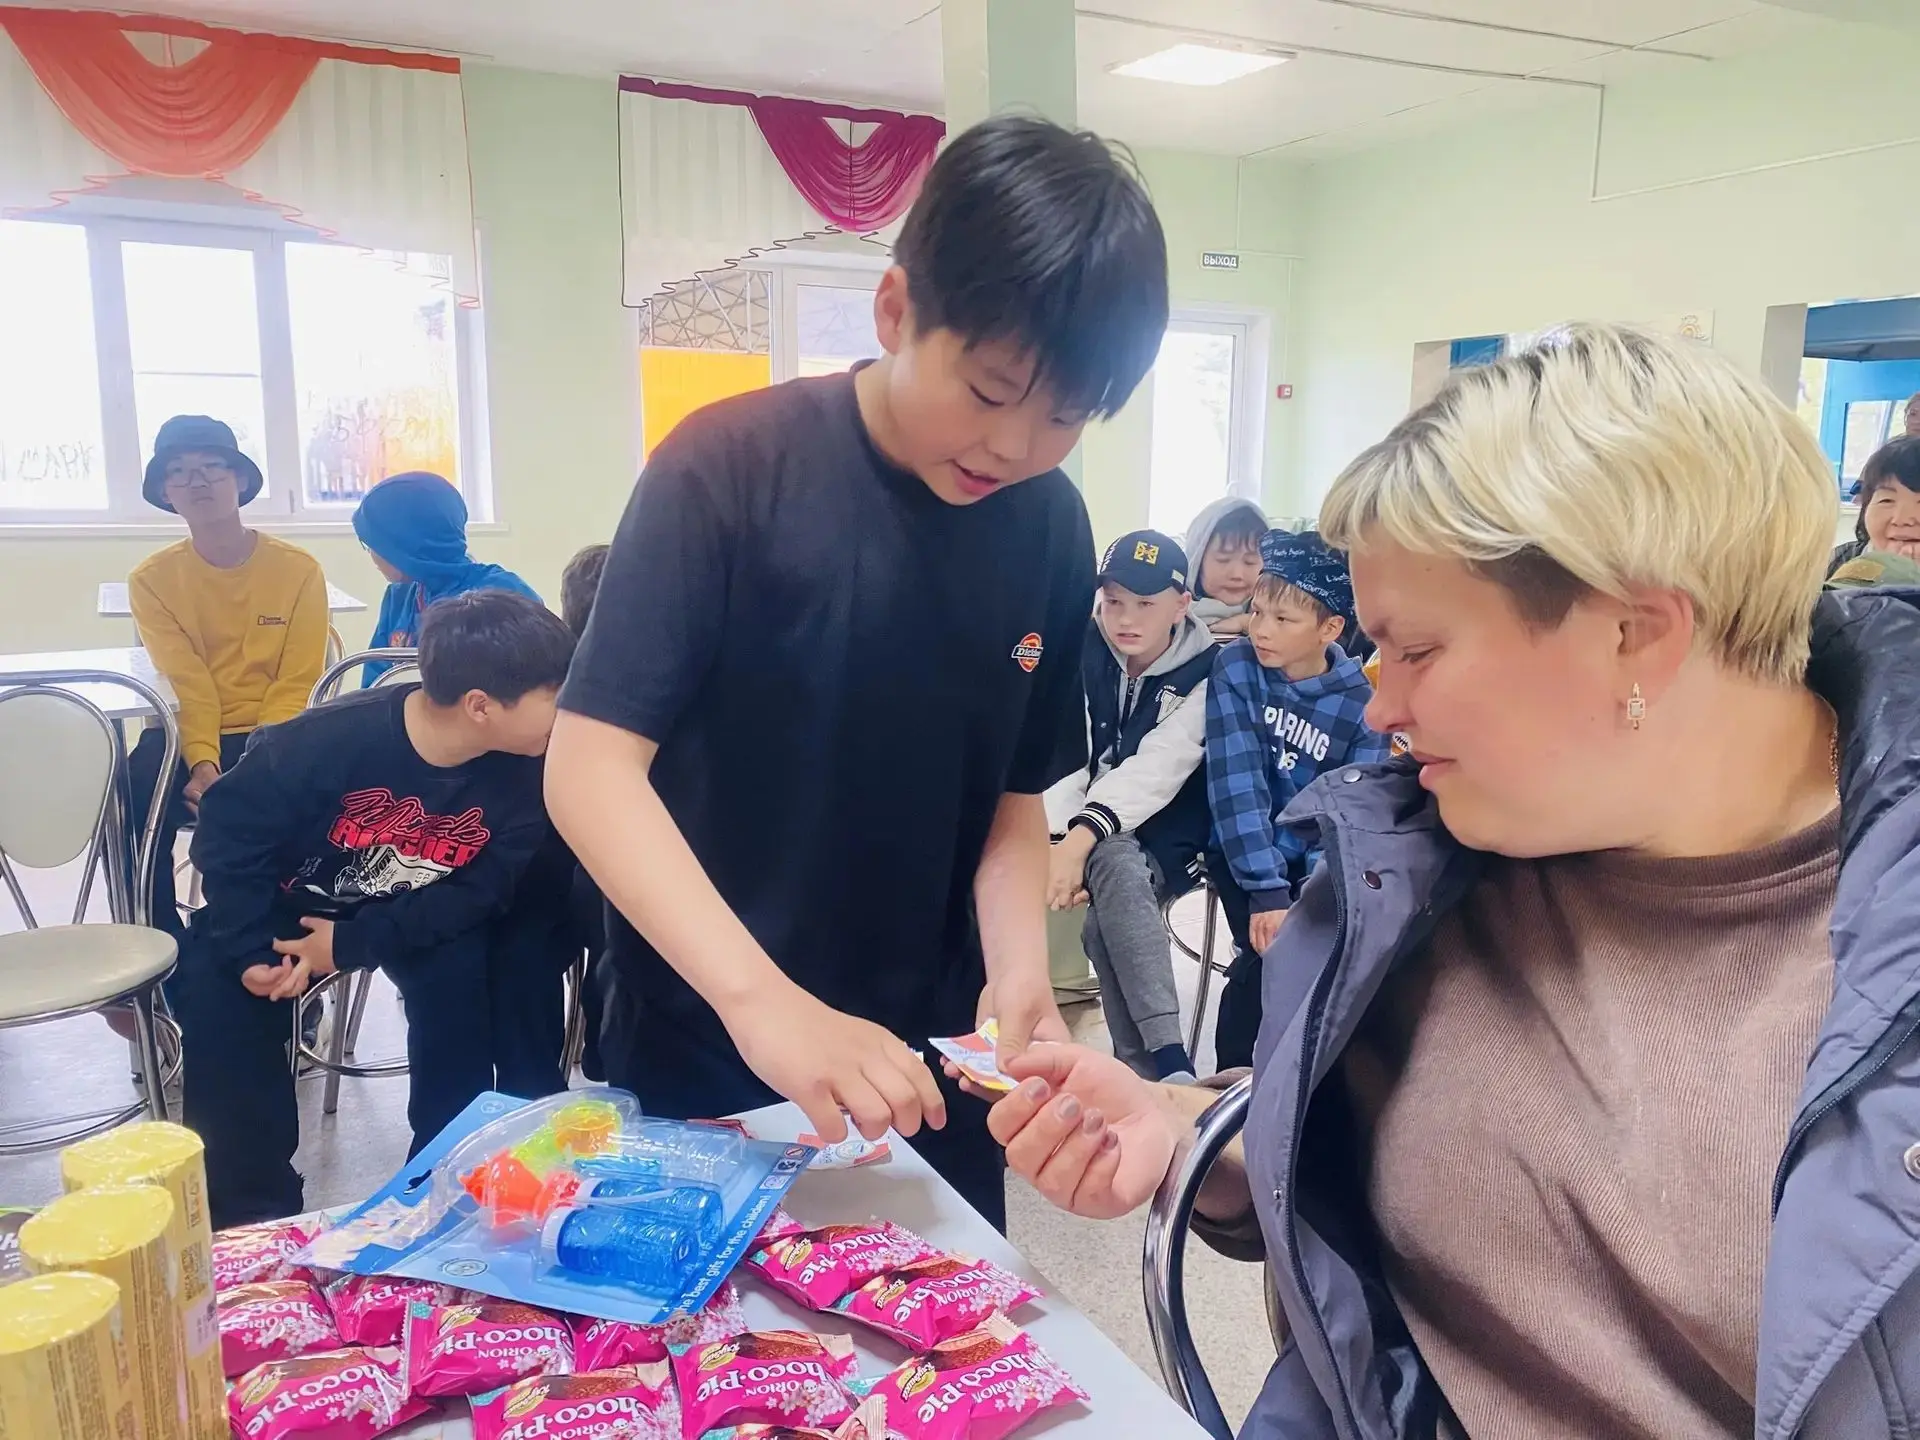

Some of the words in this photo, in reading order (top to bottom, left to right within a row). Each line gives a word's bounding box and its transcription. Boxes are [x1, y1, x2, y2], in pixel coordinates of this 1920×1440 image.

[1204, 254, 1237, 267] ВЫХОД
[716, 1246, 735, 1260] for
[728, 1230, 746, 1246] the
[215, 1257, 257, 1272] ORIO
[937, 1286, 979, 1305] ORION
[477, 1347, 533, 1359] ORION
[745, 1380, 800, 1396] ORION
[971, 1379, 1019, 1403] ORION
[302, 1390, 359, 1413] ORION
[550, 1422, 608, 1440] ORION
